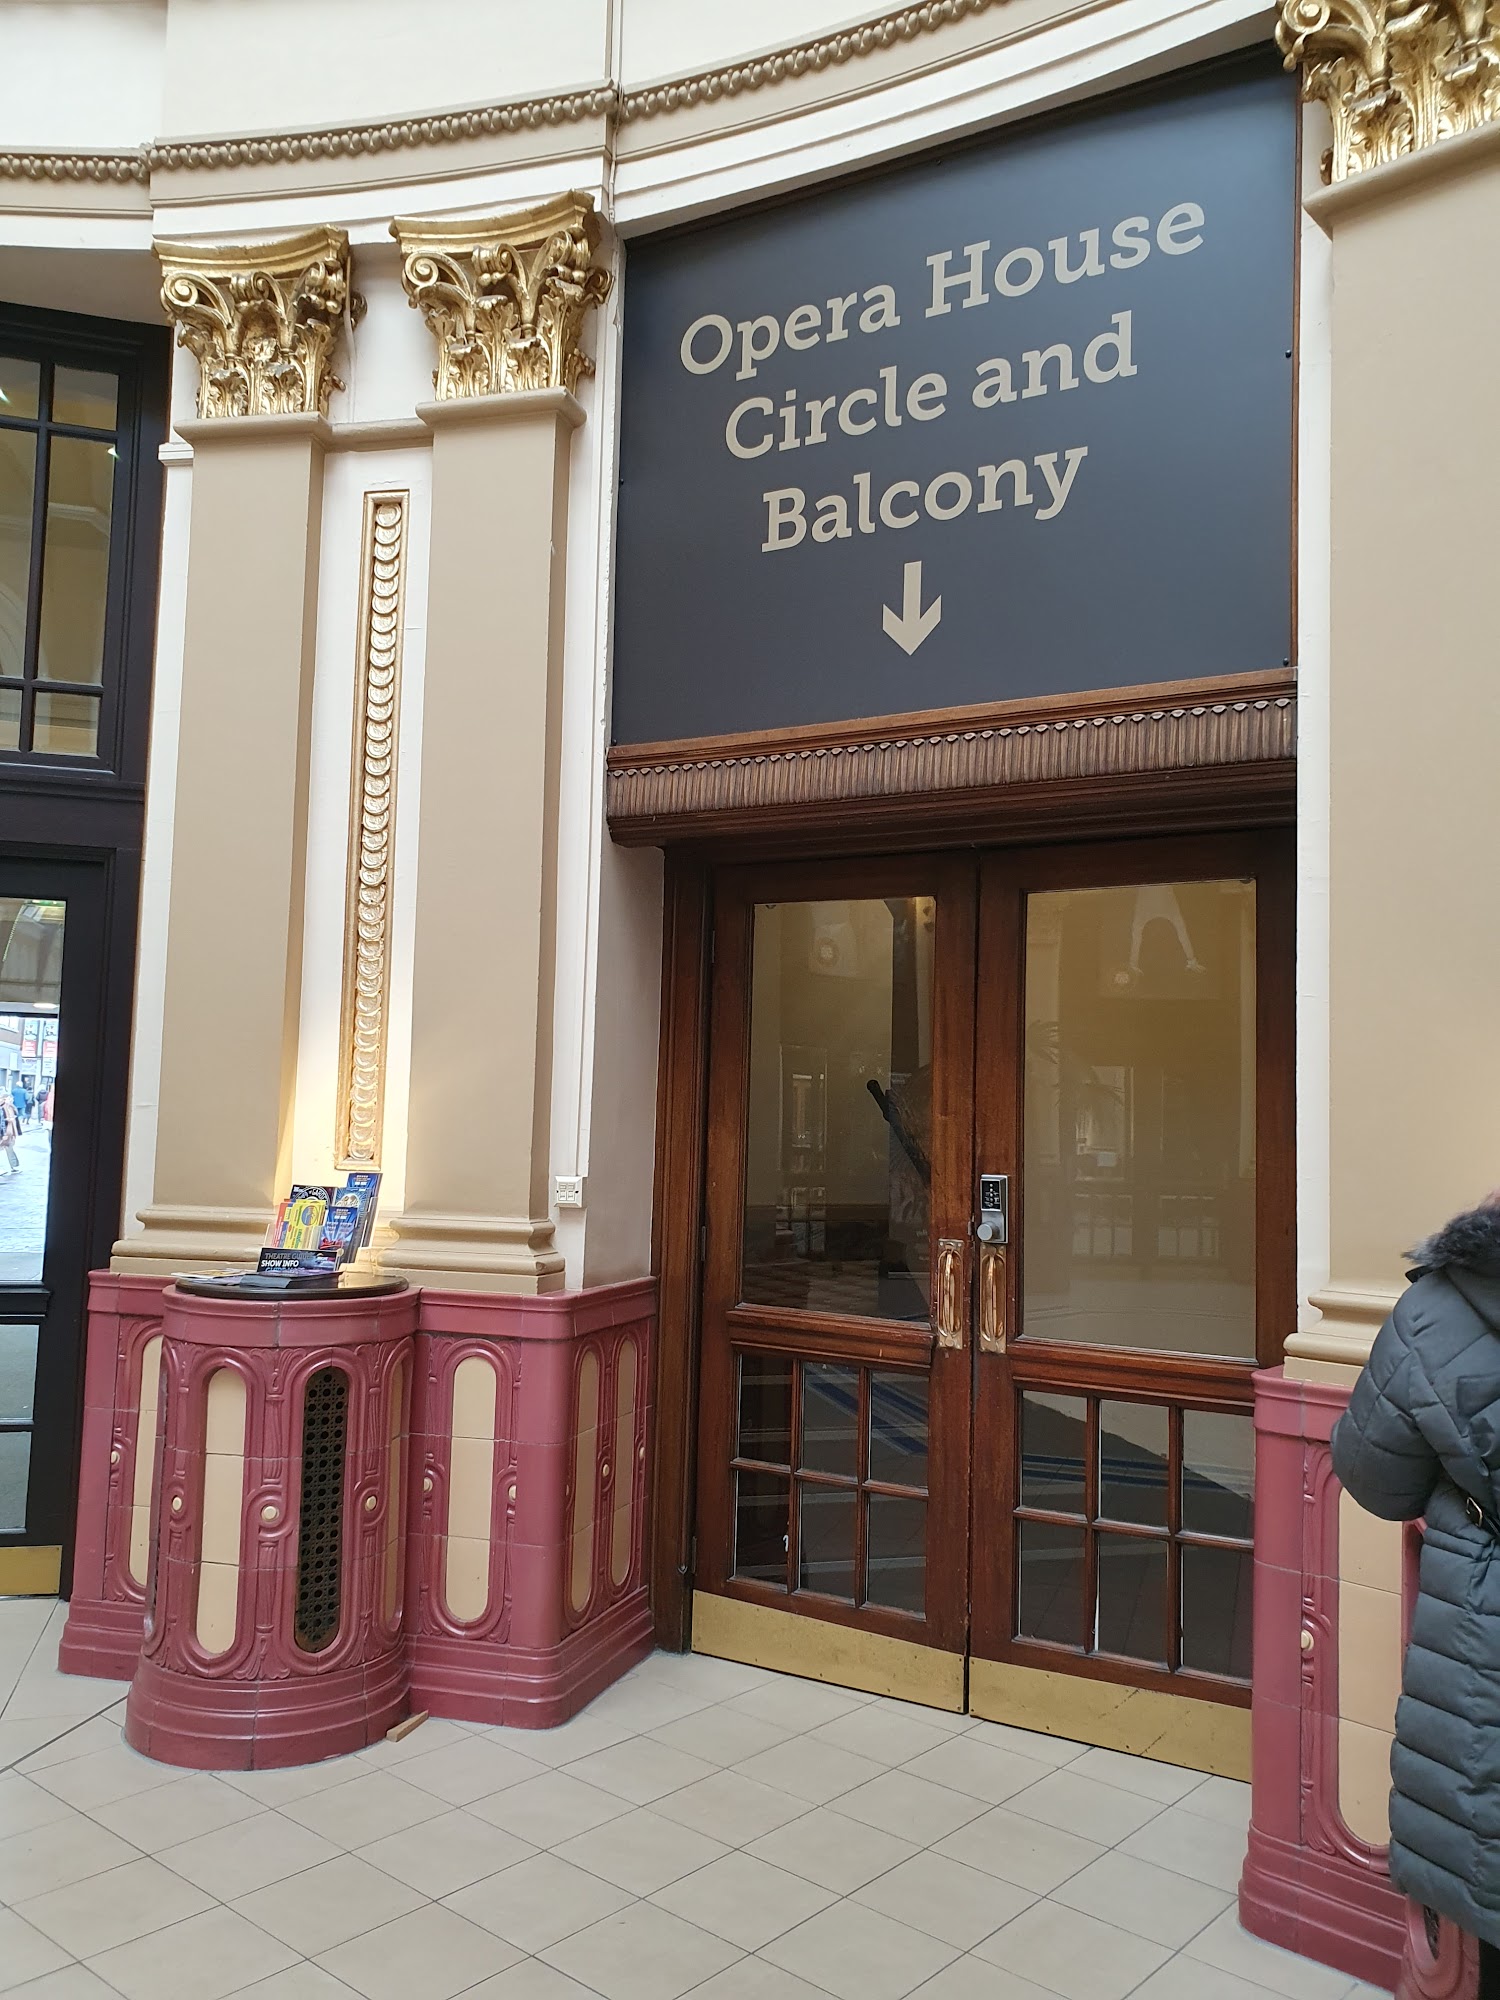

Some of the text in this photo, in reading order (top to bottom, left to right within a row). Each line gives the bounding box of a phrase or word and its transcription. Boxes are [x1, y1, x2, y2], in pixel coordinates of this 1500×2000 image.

[680, 201, 1206, 382] Opera House
[725, 309, 1139, 460] Circle and
[761, 445, 1089, 554] Balcony
[260, 1259, 300, 1268] SHOW INFO
[265, 1252, 291, 1260] THEATRE
